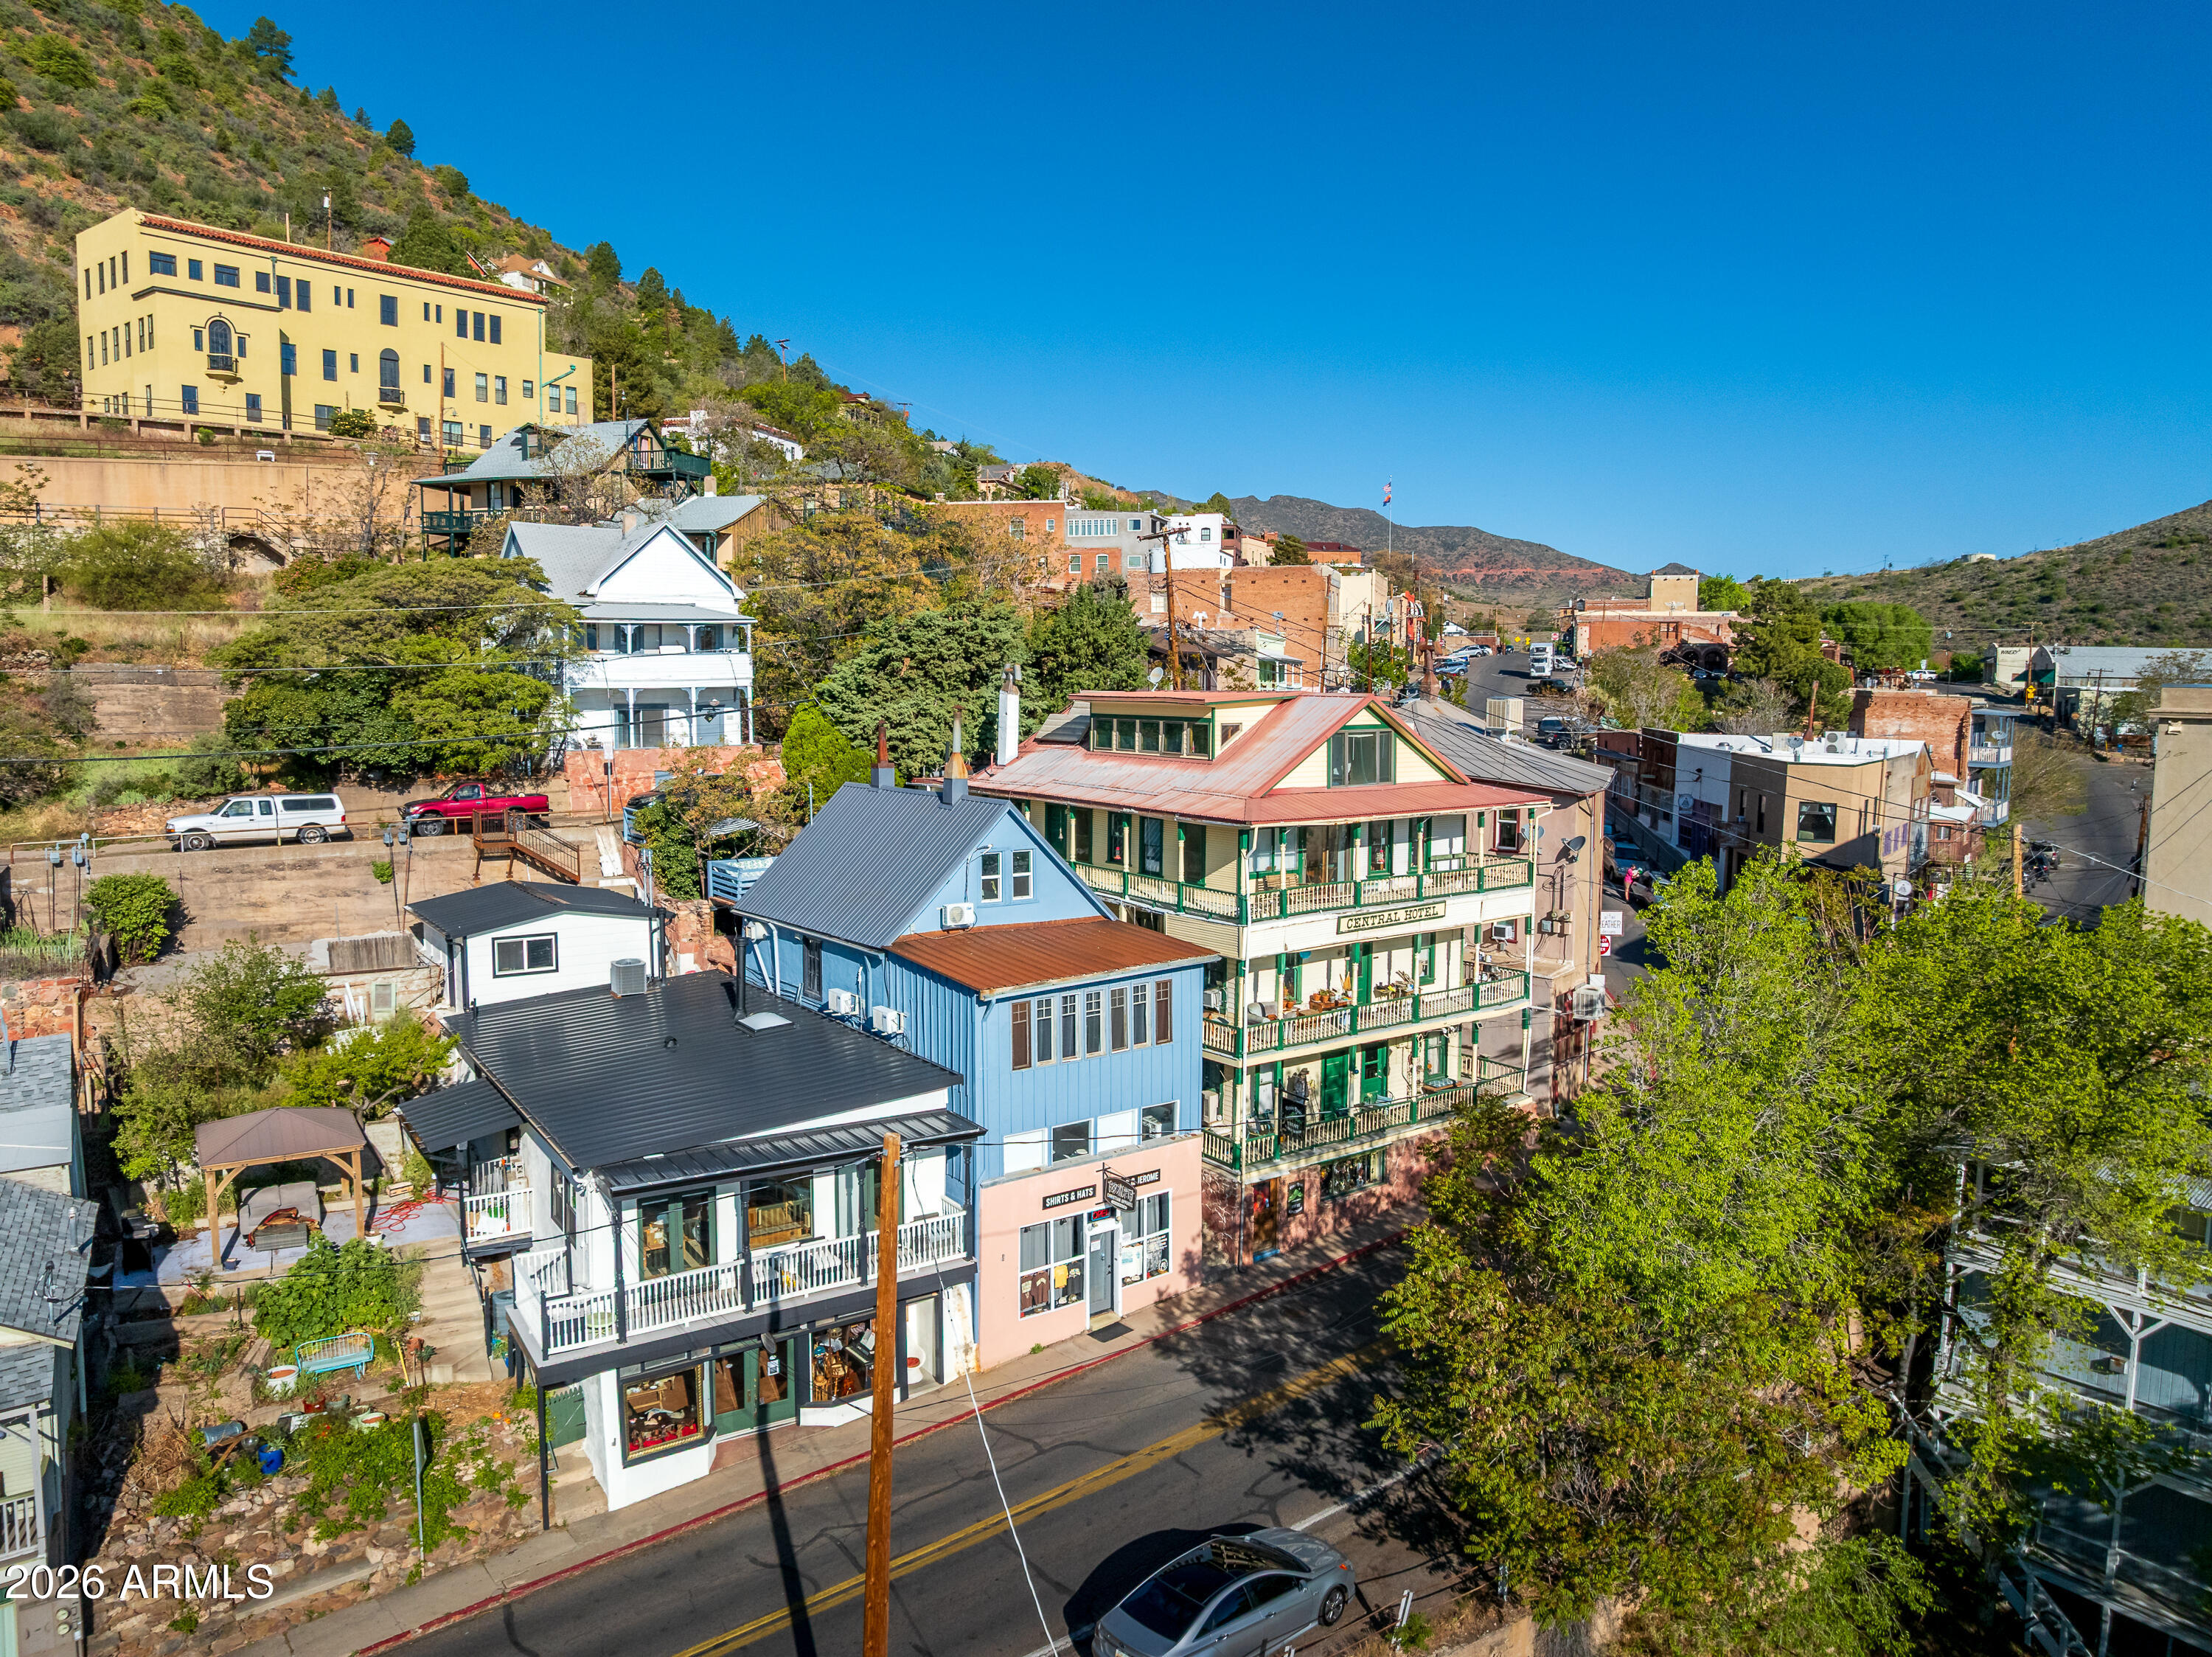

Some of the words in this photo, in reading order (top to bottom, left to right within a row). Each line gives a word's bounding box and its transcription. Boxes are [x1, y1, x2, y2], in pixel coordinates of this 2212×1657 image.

[1346, 911, 1400, 929] CENTRAL
[1404, 906, 1439, 921] HOTEL
[1137, 1171, 1159, 1185] JEROME
[1046, 1193, 1069, 1207] SHIRTS
[1070, 1191, 1076, 1201] &
[1077, 1187, 1093, 1199] HATS
